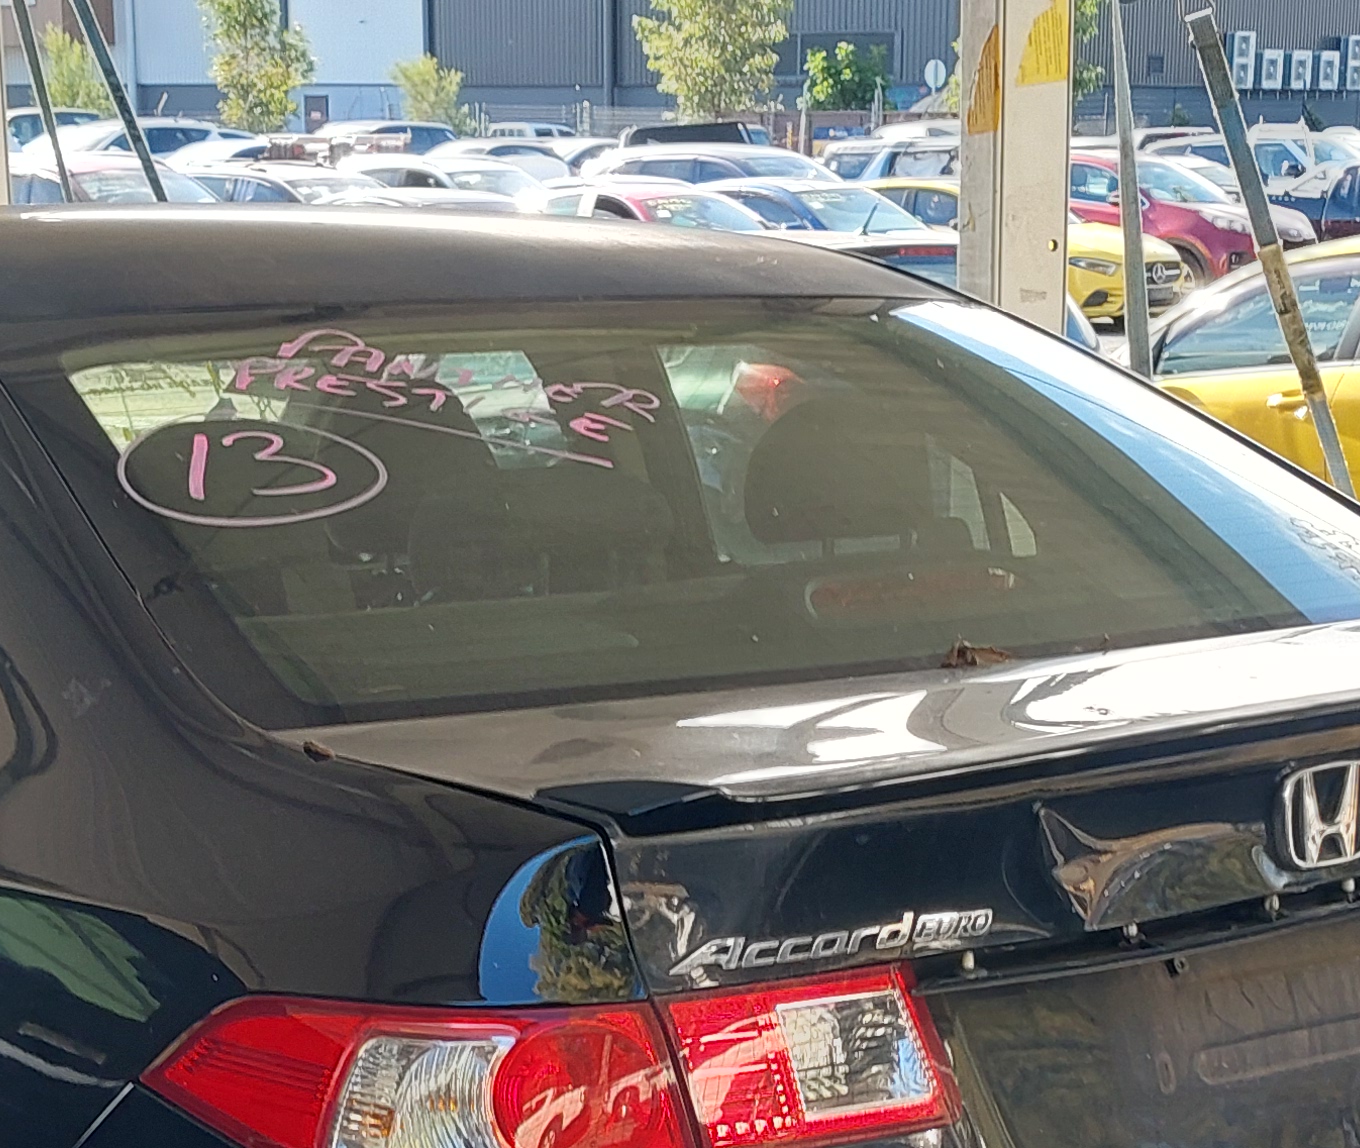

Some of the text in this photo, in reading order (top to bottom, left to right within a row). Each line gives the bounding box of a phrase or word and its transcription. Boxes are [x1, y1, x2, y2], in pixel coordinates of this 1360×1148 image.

[187, 430, 338, 501] 13
[669, 908, 993, 976] Accord EURO
